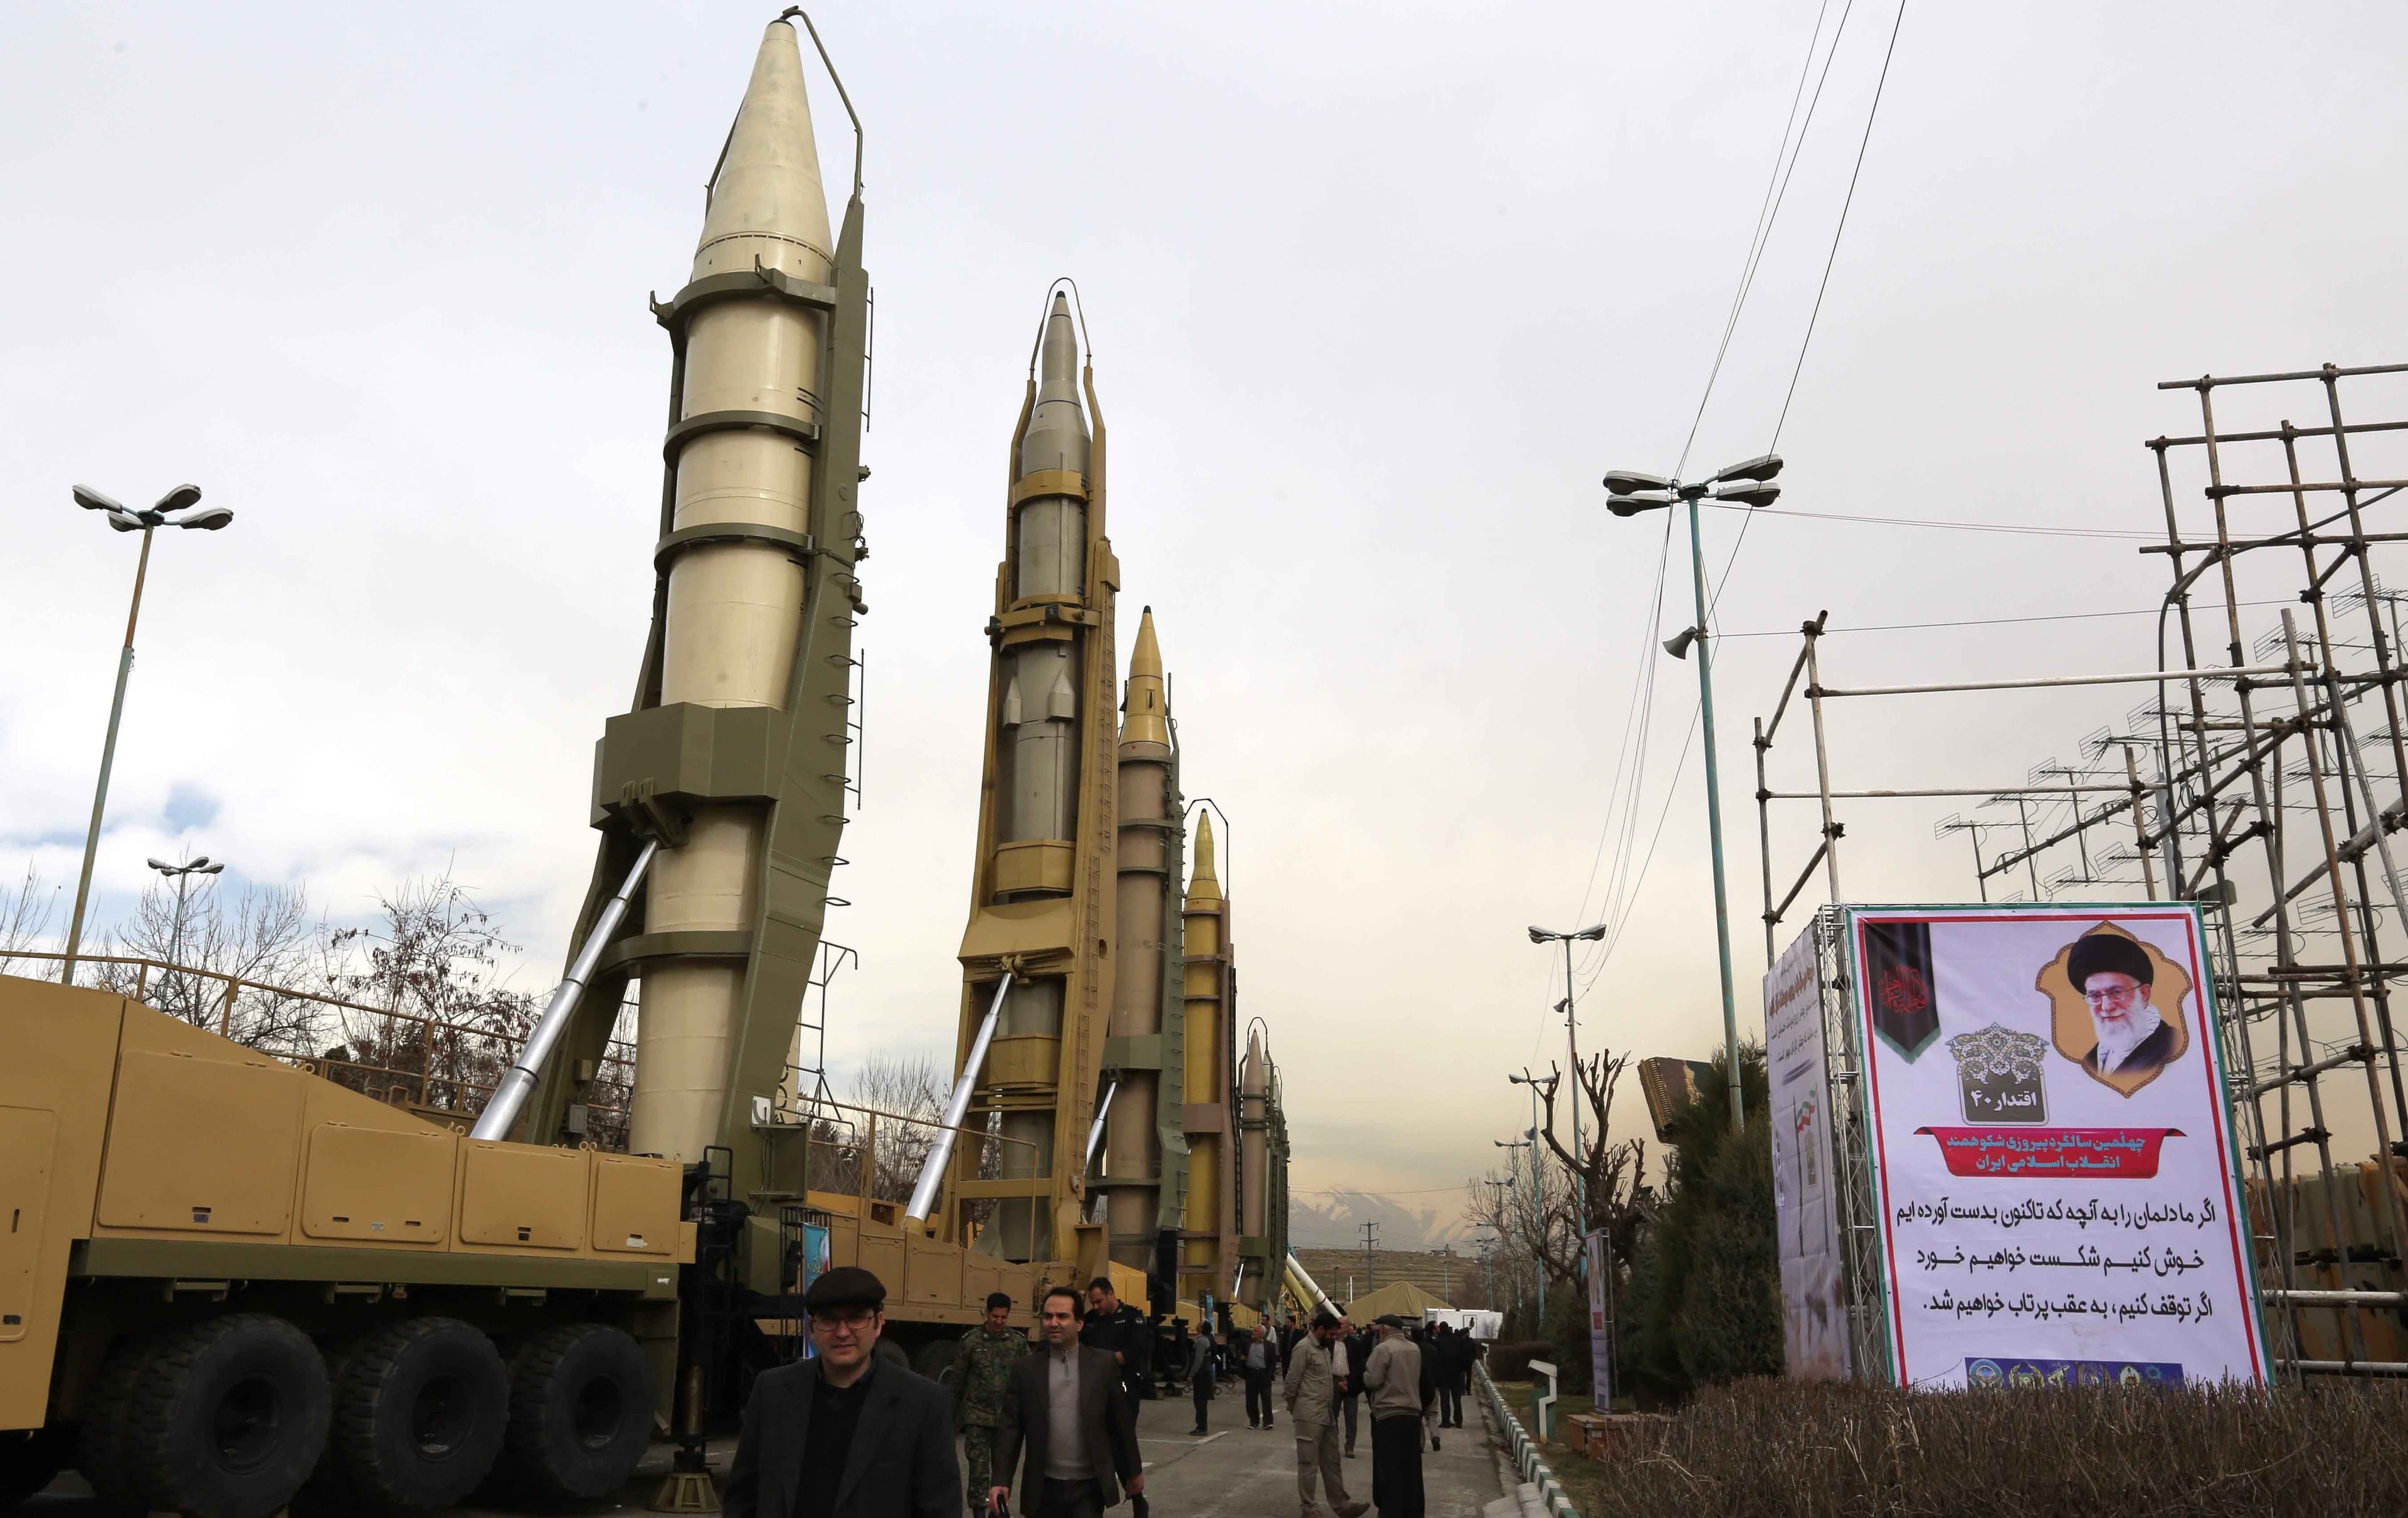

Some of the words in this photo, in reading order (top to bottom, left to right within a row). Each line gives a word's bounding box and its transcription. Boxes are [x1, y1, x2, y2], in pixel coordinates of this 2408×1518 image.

[1994, 1091, 2037, 1112] اقتدار
[2006, 1136, 2049, 1153] پیروزی
[1976, 1154, 2006, 1172] ایران
[2007, 1154, 2064, 1172] اسلامی
[1896, 1200, 1915, 1227] ایم
[1918, 1196, 1949, 1226] آورده
[1950, 1205, 1998, 1225] بدست
[2000, 1198, 2044, 1228] تاکنون
[2046, 1198, 2063, 1220] که
[2066, 1199, 2099, 1229] آنچه
[2101, 1206, 2118, 1226] به
[2120, 1203, 2131, 1229] را
[2133, 1202, 2178, 1230] دلمان
[2178, 1202, 2194, 1223] ما
[2197, 1197, 2216, 1230] اگر
[1969, 1246, 2026, 1274] خواهیم
[2029, 1245, 2101, 1267] شکست
[2103, 1246, 2151, 1276] کنیم
[1923, 1289, 1954, 1310] شد.
[1956, 1292, 2005, 1320] خواهیم
[2008, 1292, 2049, 1321] پرتاب
[2051, 1293, 2088, 1319] عقب
[2090, 1299, 2108, 1320] به
[2150, 1294, 2192, 1324] توقف
[2194, 1290, 2213, 1324] اگر
